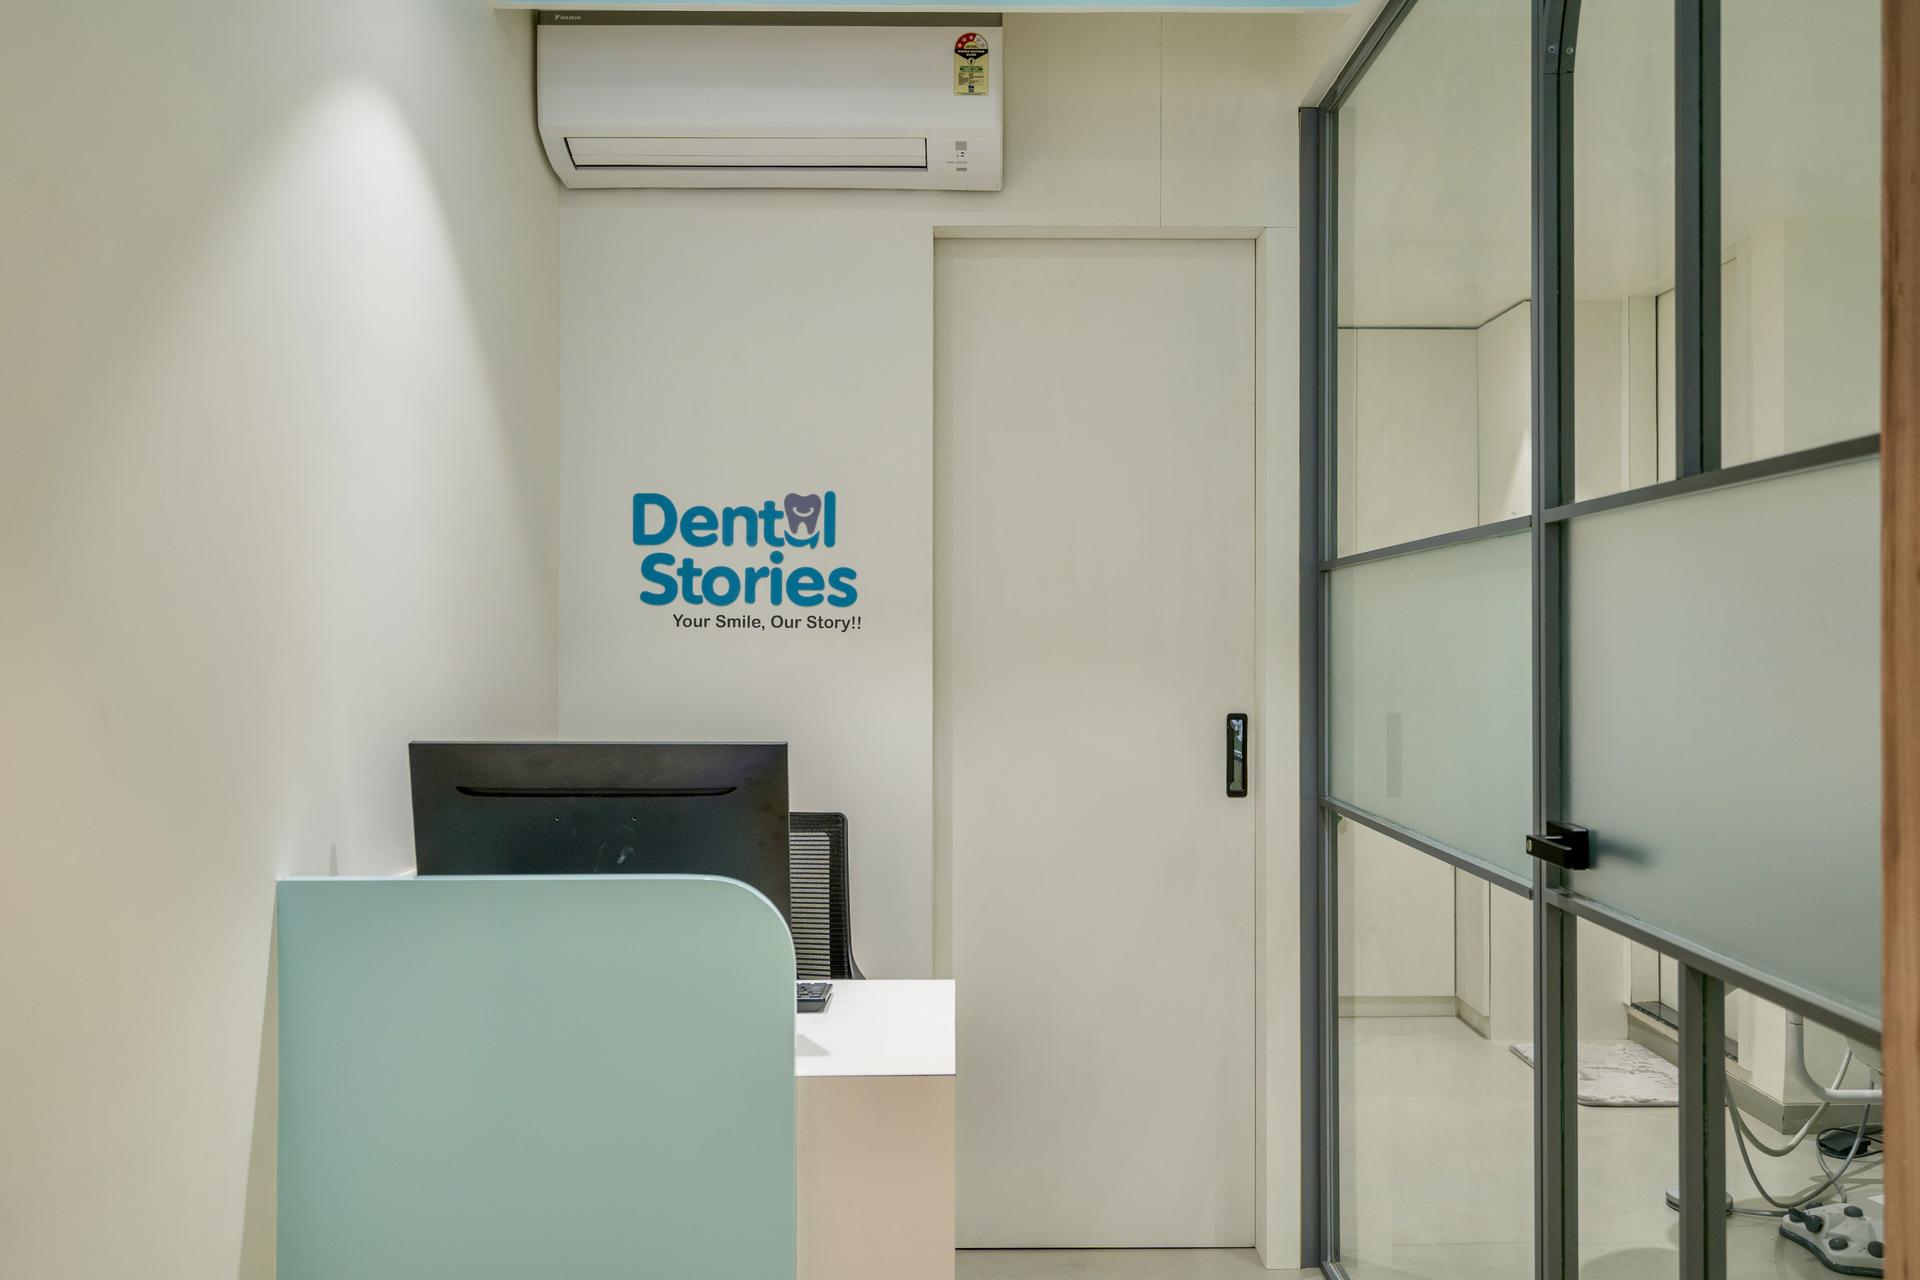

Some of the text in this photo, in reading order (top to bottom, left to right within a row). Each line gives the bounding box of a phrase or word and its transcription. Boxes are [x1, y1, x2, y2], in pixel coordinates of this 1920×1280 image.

[632, 490, 837, 549] Dental
[639, 550, 859, 607] Stories
[673, 614, 862, 632] Your Smile, Our Story!!
